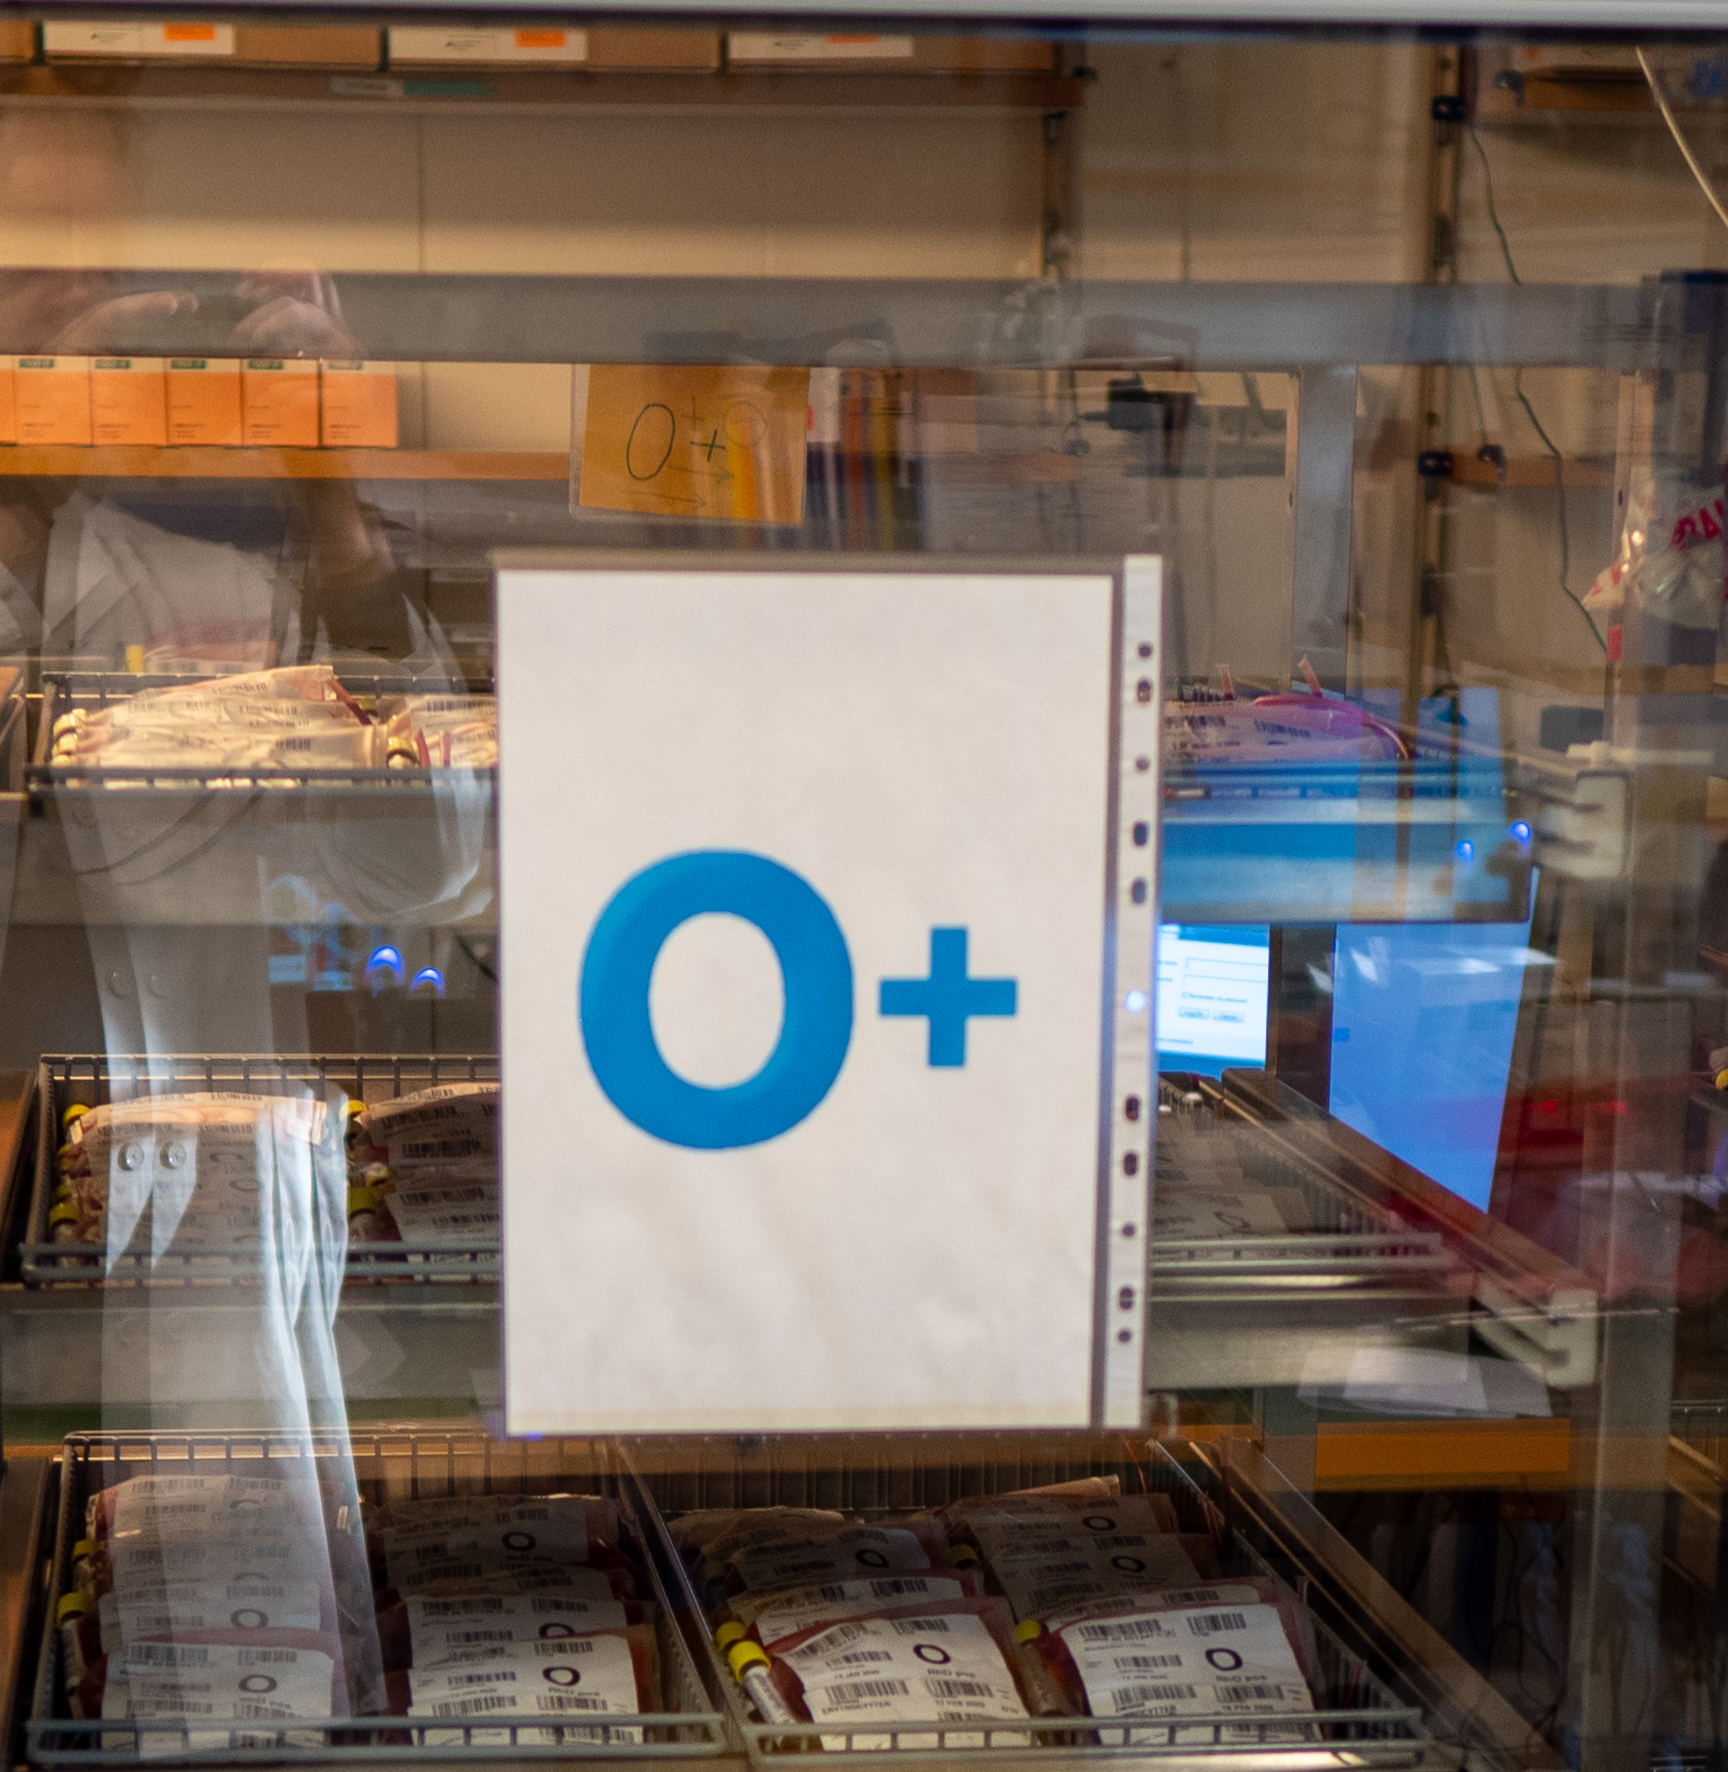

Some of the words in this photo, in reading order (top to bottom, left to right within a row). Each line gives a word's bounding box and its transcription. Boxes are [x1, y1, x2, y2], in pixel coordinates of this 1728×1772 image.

[579, 850, 1018, 1151] O+
[1081, 1516, 1117, 1533] O
[501, 1531, 536, 1552] O
[854, 1548, 891, 1570] O
[1110, 1556, 1147, 1574] O
[230, 1609, 268, 1631] O
[912, 1643, 952, 1665] O
[1204, 1647, 1244, 1672] O
[237, 1673, 278, 1693] O
[542, 1666, 581, 1687] O
